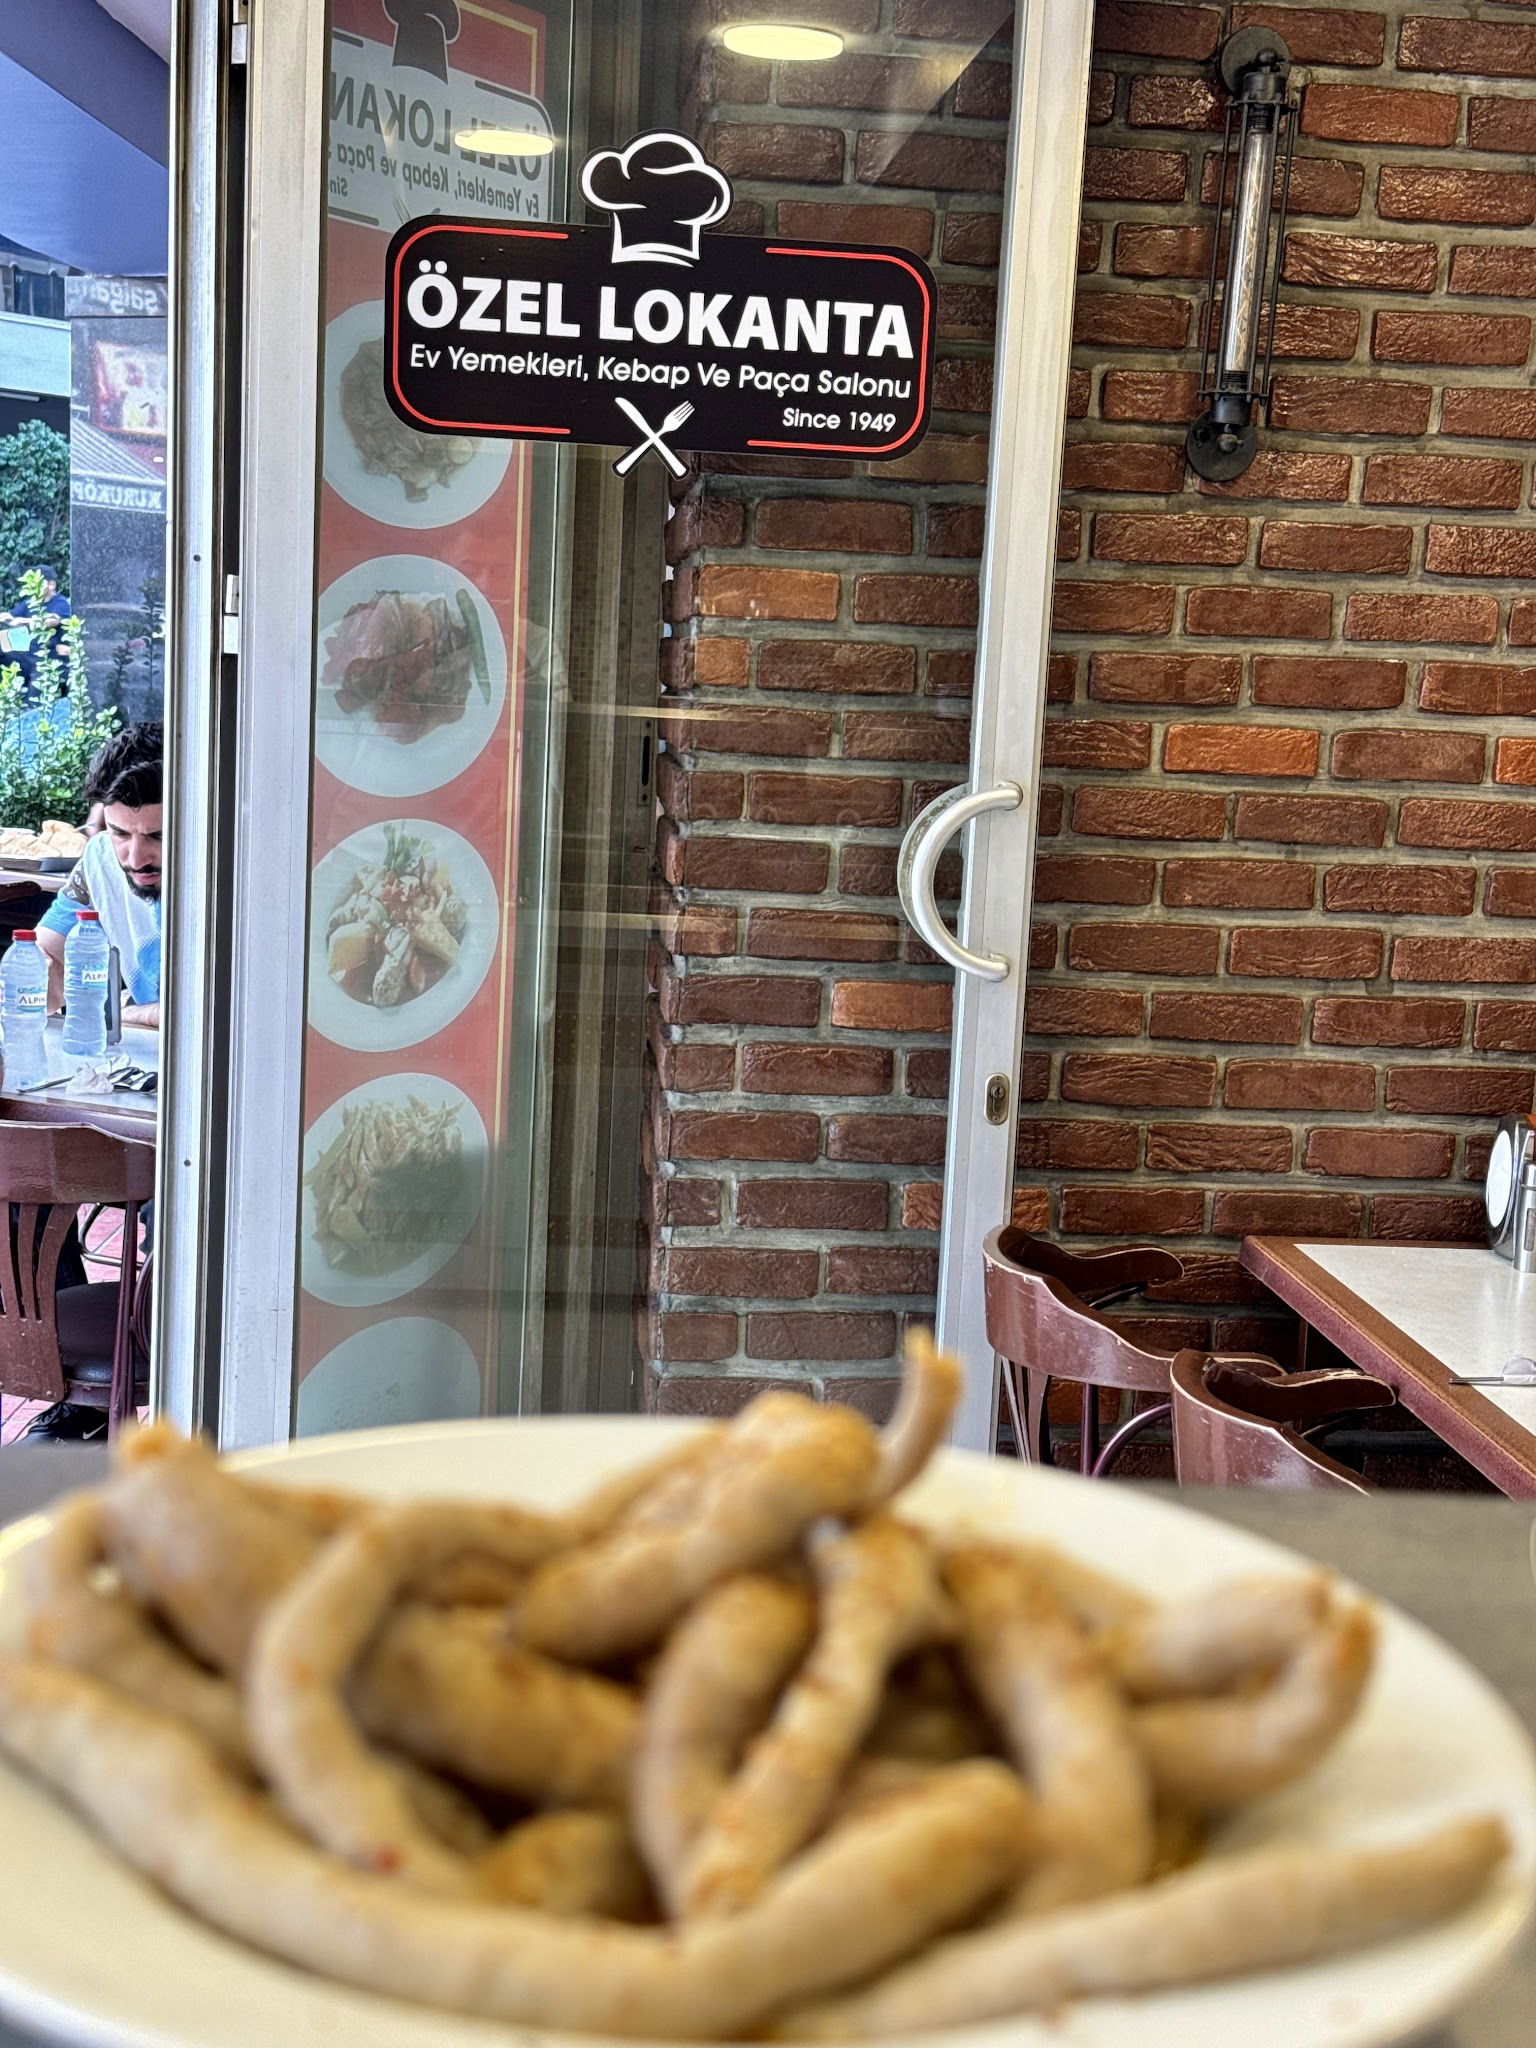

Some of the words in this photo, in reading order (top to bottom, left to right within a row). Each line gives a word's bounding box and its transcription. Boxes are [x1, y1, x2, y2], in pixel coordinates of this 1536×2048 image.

[407, 259, 581, 338] ÖZEL
[599, 286, 914, 359] LOKANTA
[410, 343, 442, 370] Ev
[447, 345, 589, 383] Yemekleri,
[597, 355, 690, 390] Kebap
[697, 362, 731, 388] Ve
[738, 368, 810, 398] Paça
[817, 371, 911, 399] Salonu
[782, 407, 841, 430] Since
[849, 411, 897, 433] 1949
